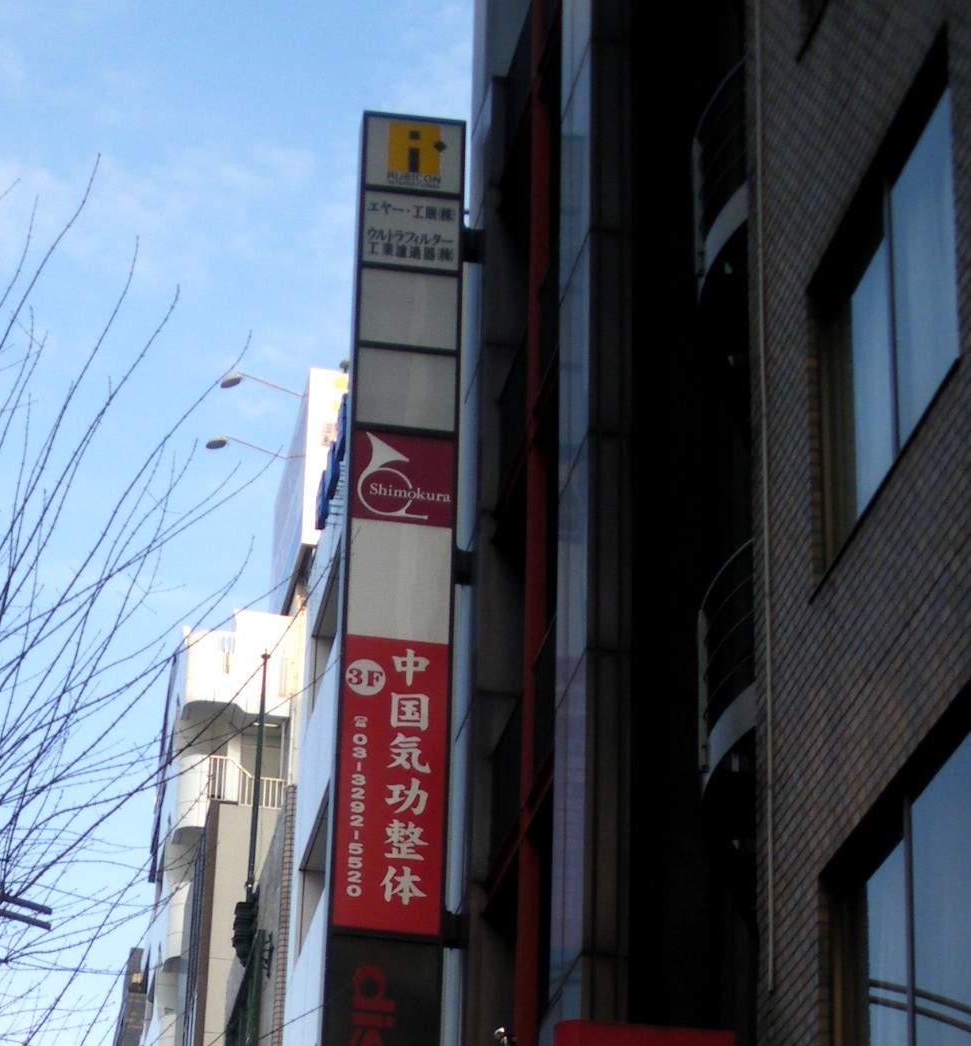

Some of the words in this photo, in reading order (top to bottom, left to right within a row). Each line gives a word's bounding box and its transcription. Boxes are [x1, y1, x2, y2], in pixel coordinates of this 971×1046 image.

[387, 171, 441, 184] RUBICON
[367, 226, 453, 246] ウルトラフィルター
[368, 481, 451, 503] Shimokura
[347, 667, 383, 688] 3F
[380, 649, 431, 906] 中国気功整体
